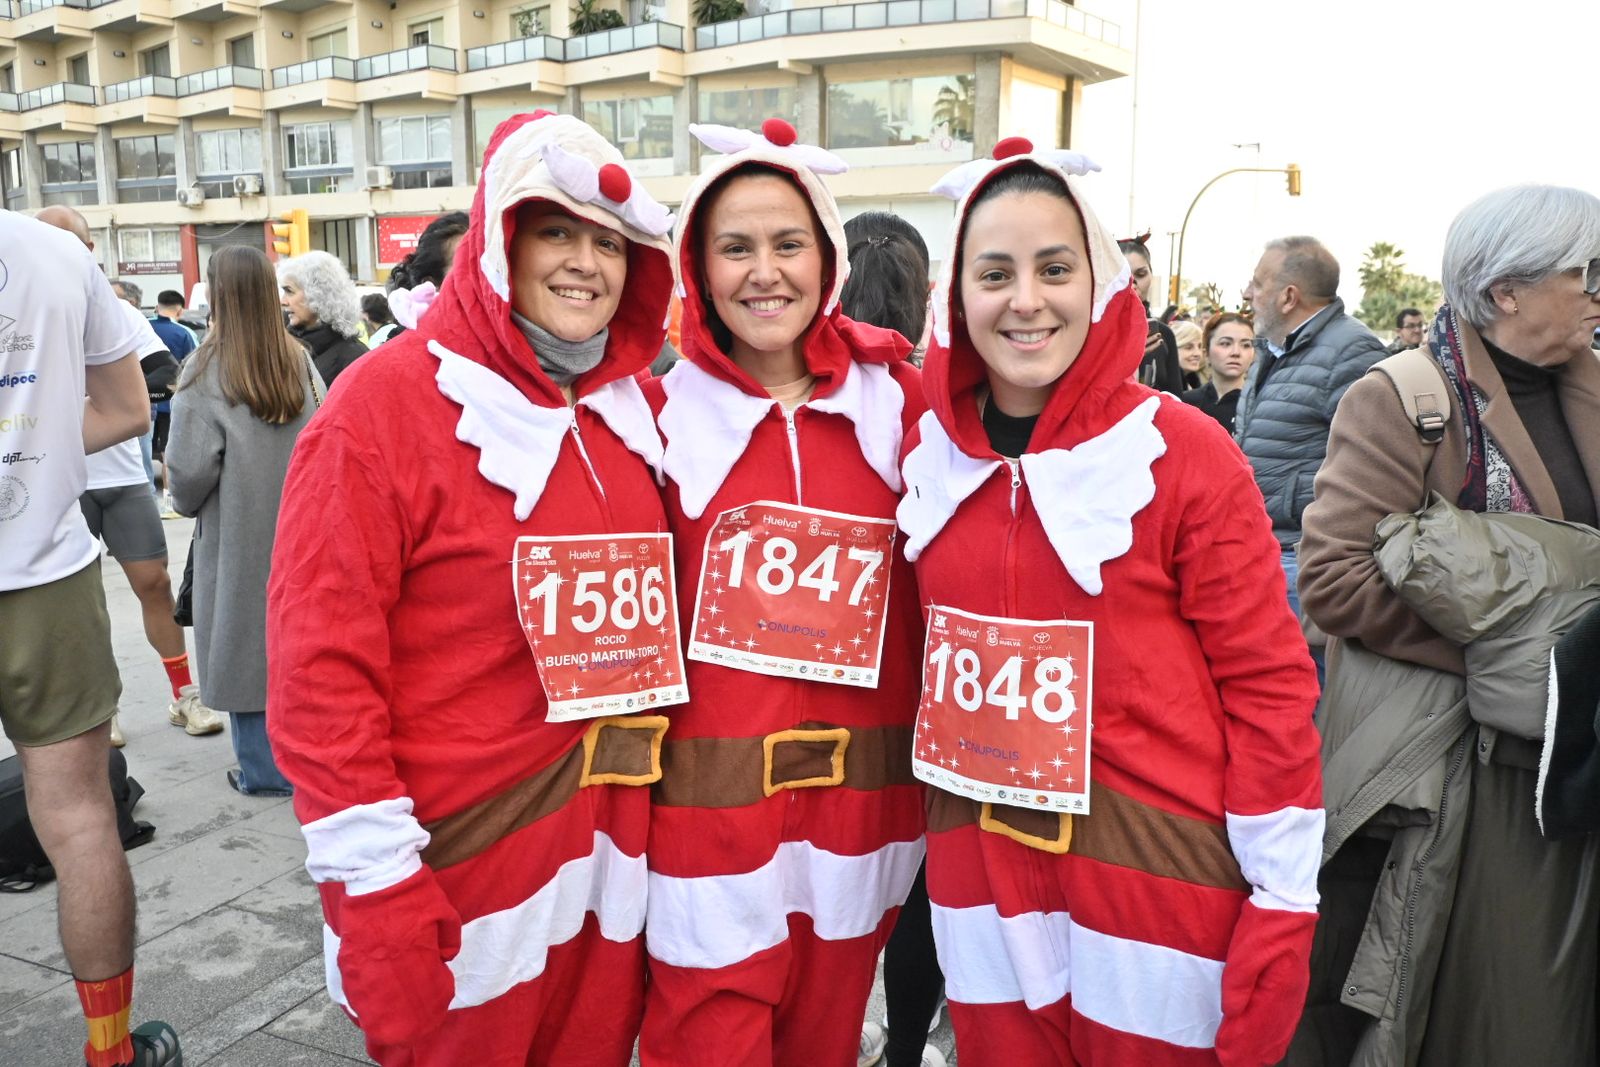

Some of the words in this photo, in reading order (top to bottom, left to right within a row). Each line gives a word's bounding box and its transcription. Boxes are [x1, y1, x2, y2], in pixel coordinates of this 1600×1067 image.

[763, 514, 800, 529] Huelva
[529, 545, 552, 560] 5K
[569, 549, 601, 560] Huelva
[719, 530, 884, 607] 1847
[529, 566, 667, 636] 1586
[934, 614, 947, 628] 5K
[768, 620, 827, 639] ONUPOLIS
[956, 624, 978, 639] Huelva
[595, 634, 627, 646] ROCIO
[545, 653, 588, 667] BUENO
[591, 645, 659, 663] MARTIN-TORO
[929, 641, 1076, 723] 1848
